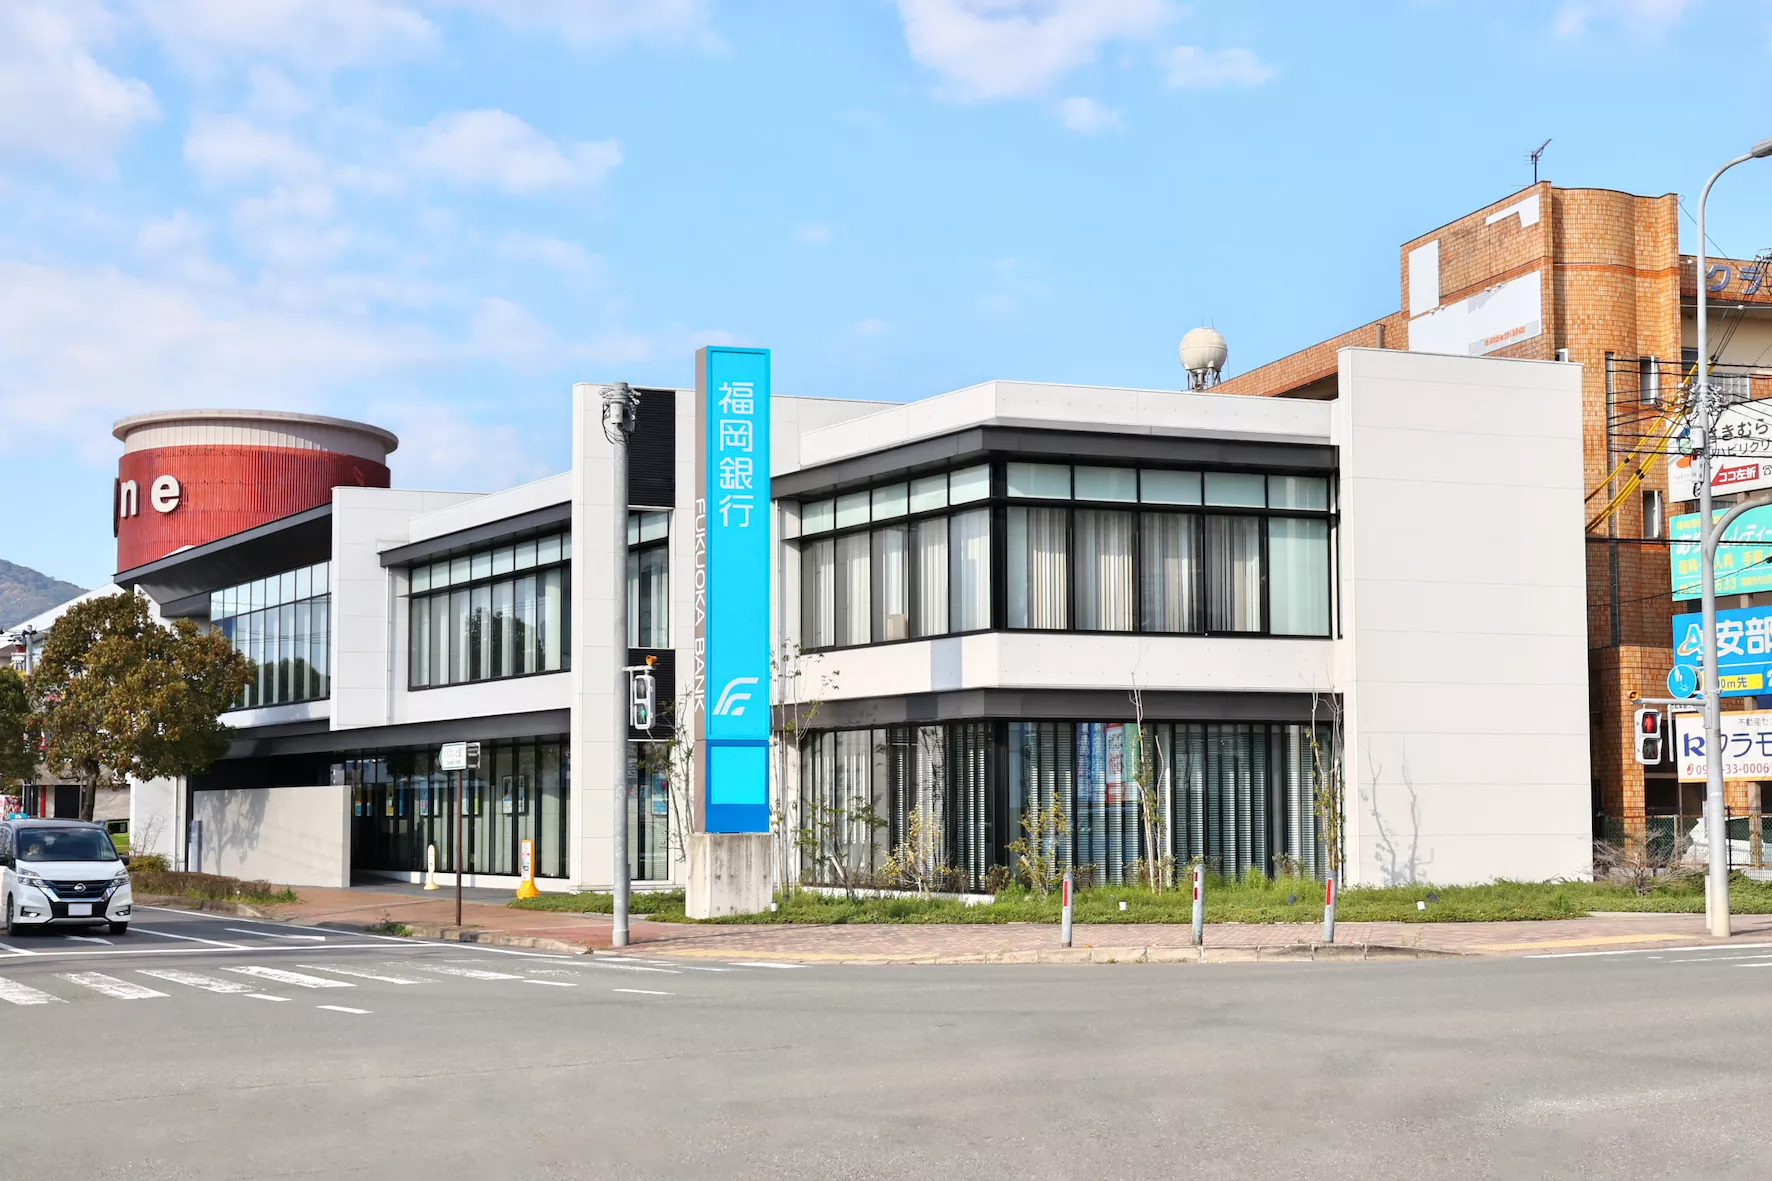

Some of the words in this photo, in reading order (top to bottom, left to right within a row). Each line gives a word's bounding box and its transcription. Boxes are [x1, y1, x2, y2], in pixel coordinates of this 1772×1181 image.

[718, 381, 754, 528] 福岡銀行
[1718, 466, 1757, 482] ココ左折
[695, 498, 706, 627] FUKUOKA
[695, 637, 705, 713] BANK
[1719, 676, 1748, 690] 0m先
